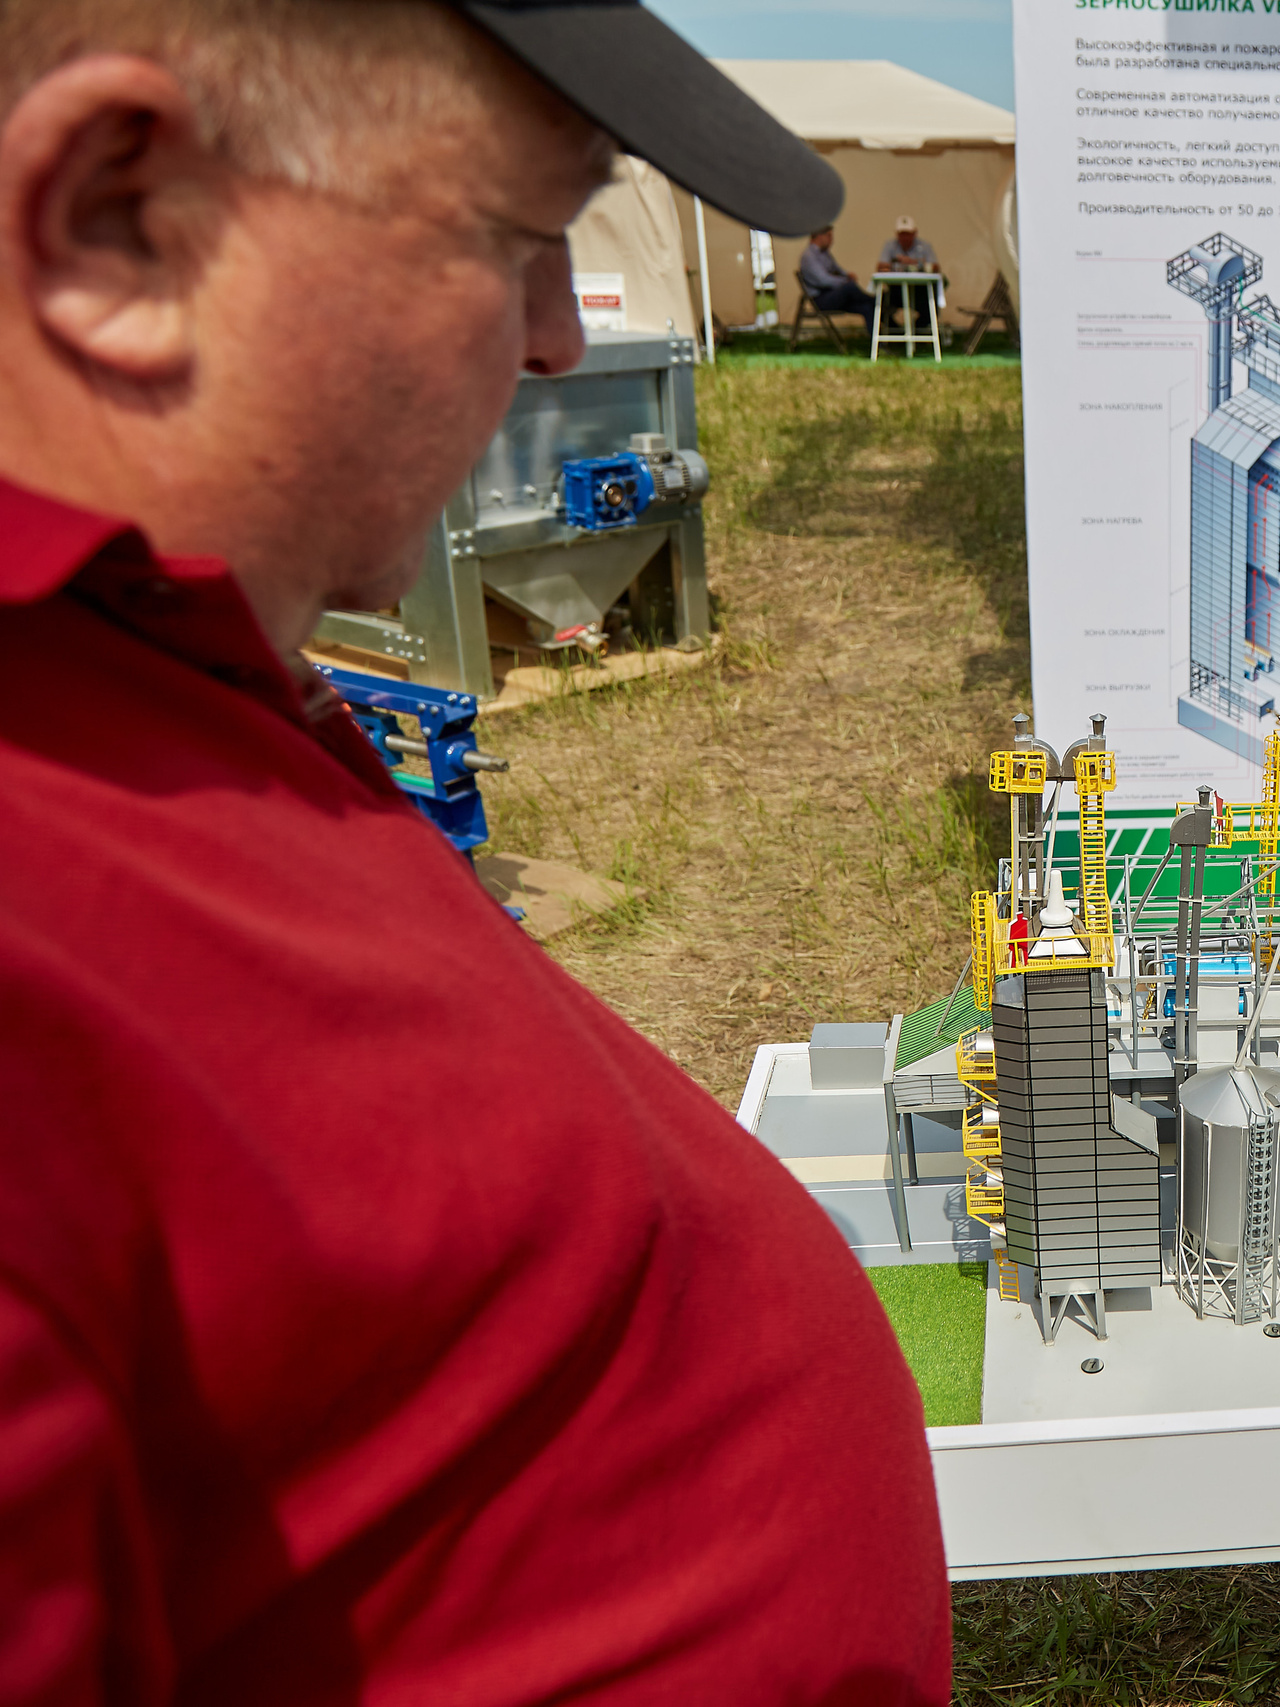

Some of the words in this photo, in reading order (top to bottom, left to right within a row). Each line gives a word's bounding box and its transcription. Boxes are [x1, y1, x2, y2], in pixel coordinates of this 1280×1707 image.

[1076, 0, 1254, 13] ЗЕРНОСУШИЛКА
[1076, 38, 1216, 54] Высокоэффективная
[1222, 44, 1229, 53] и
[1076, 54, 1110, 67] была
[1116, 57, 1200, 69] разработана
[1076, 88, 1165, 102] Современная
[1171, 92, 1269, 104] автоматизация
[1076, 107, 1138, 118] отличное
[1144, 108, 1203, 119] качество
[1077, 137, 1180, 152] Экологичность,
[1187, 140, 1230, 151] легкий
[1235, 143, 1279, 155] доступ
[1078, 156, 1132, 166] высокое
[1139, 157, 1197, 167] качество
[1078, 172, 1174, 183] долговечность
[1179, 172, 1276, 185] оборудования.
[1079, 202, 1214, 216] Производительность
[1219, 206, 1231, 216] от
[1239, 204, 1253, 216] 50
[1258, 207, 1273, 217] до
